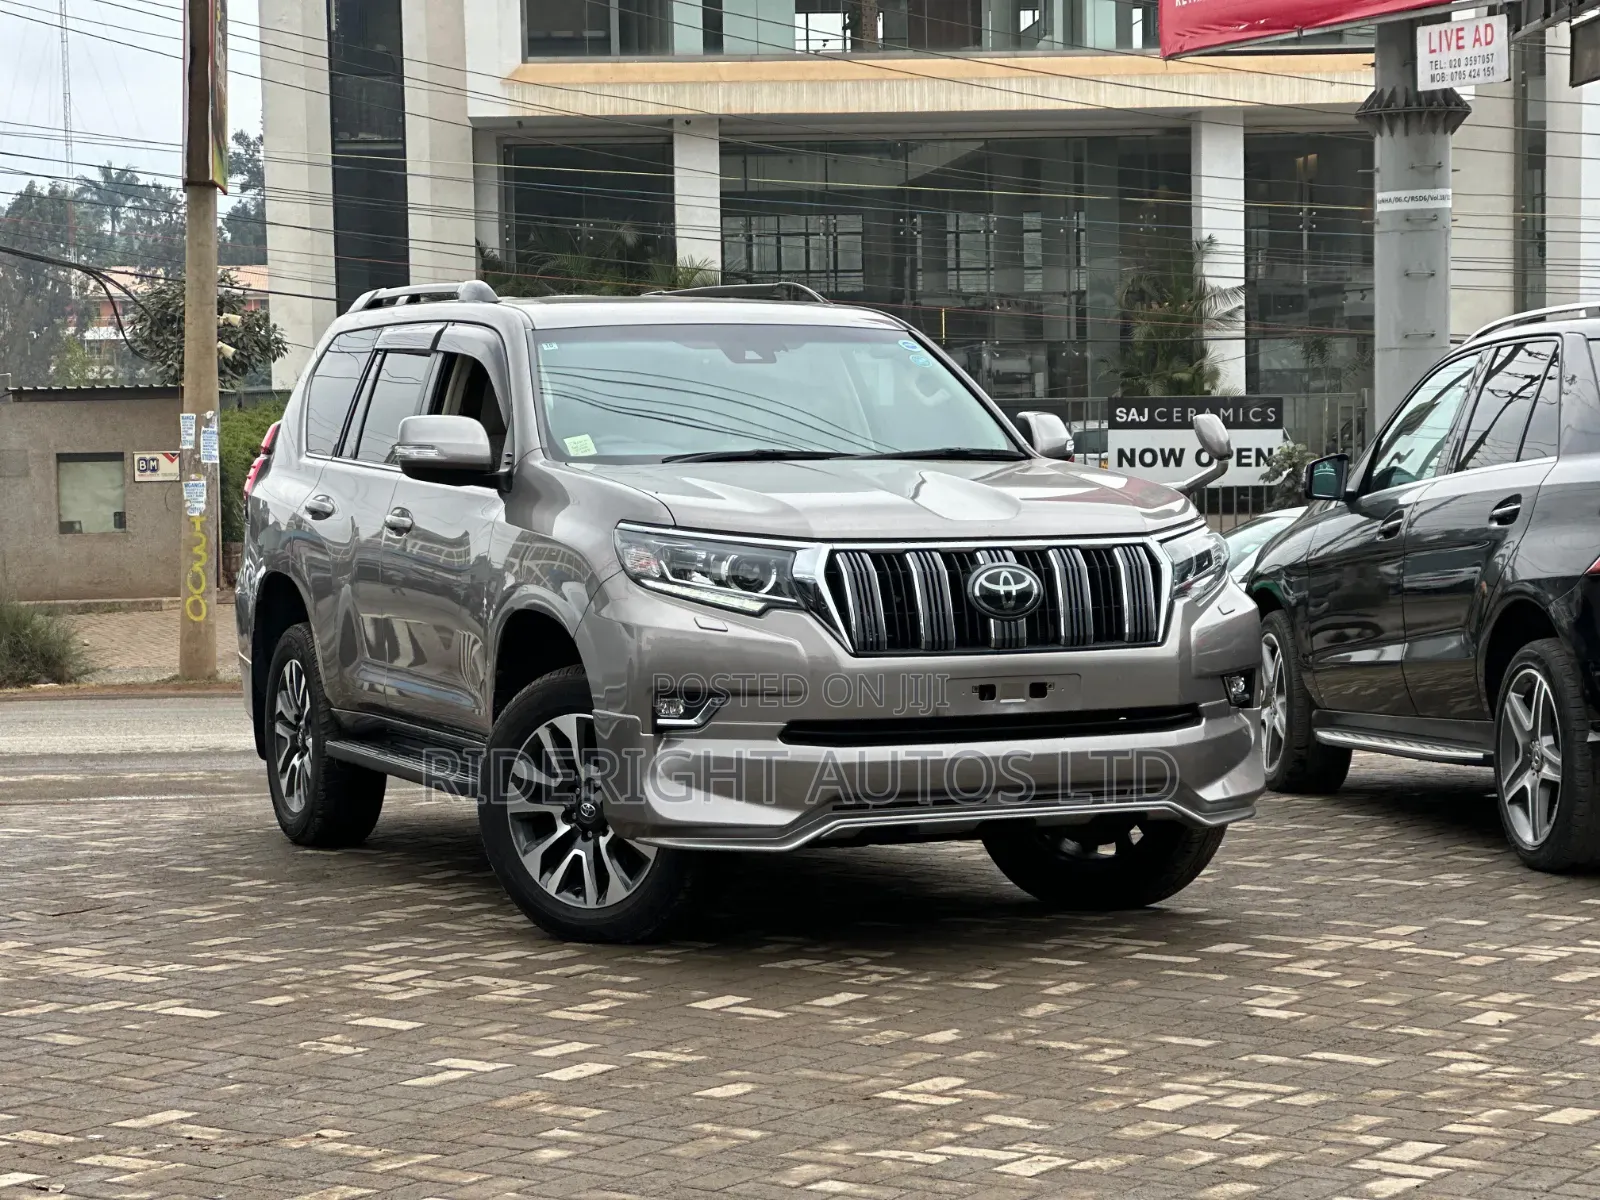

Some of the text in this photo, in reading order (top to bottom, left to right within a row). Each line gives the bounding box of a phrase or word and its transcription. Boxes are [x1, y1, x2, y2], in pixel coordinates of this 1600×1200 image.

[1428, 23, 1494, 54] LIVE AD
[1430, 53, 1494, 70] TEL: 020 3597057
[1430, 66, 1494, 83] MOB: 0705 424 151
[1115, 407, 1149, 422] SAJ
[138, 459, 158, 471] BM
[1117, 447, 1274, 468] NOW OEN
